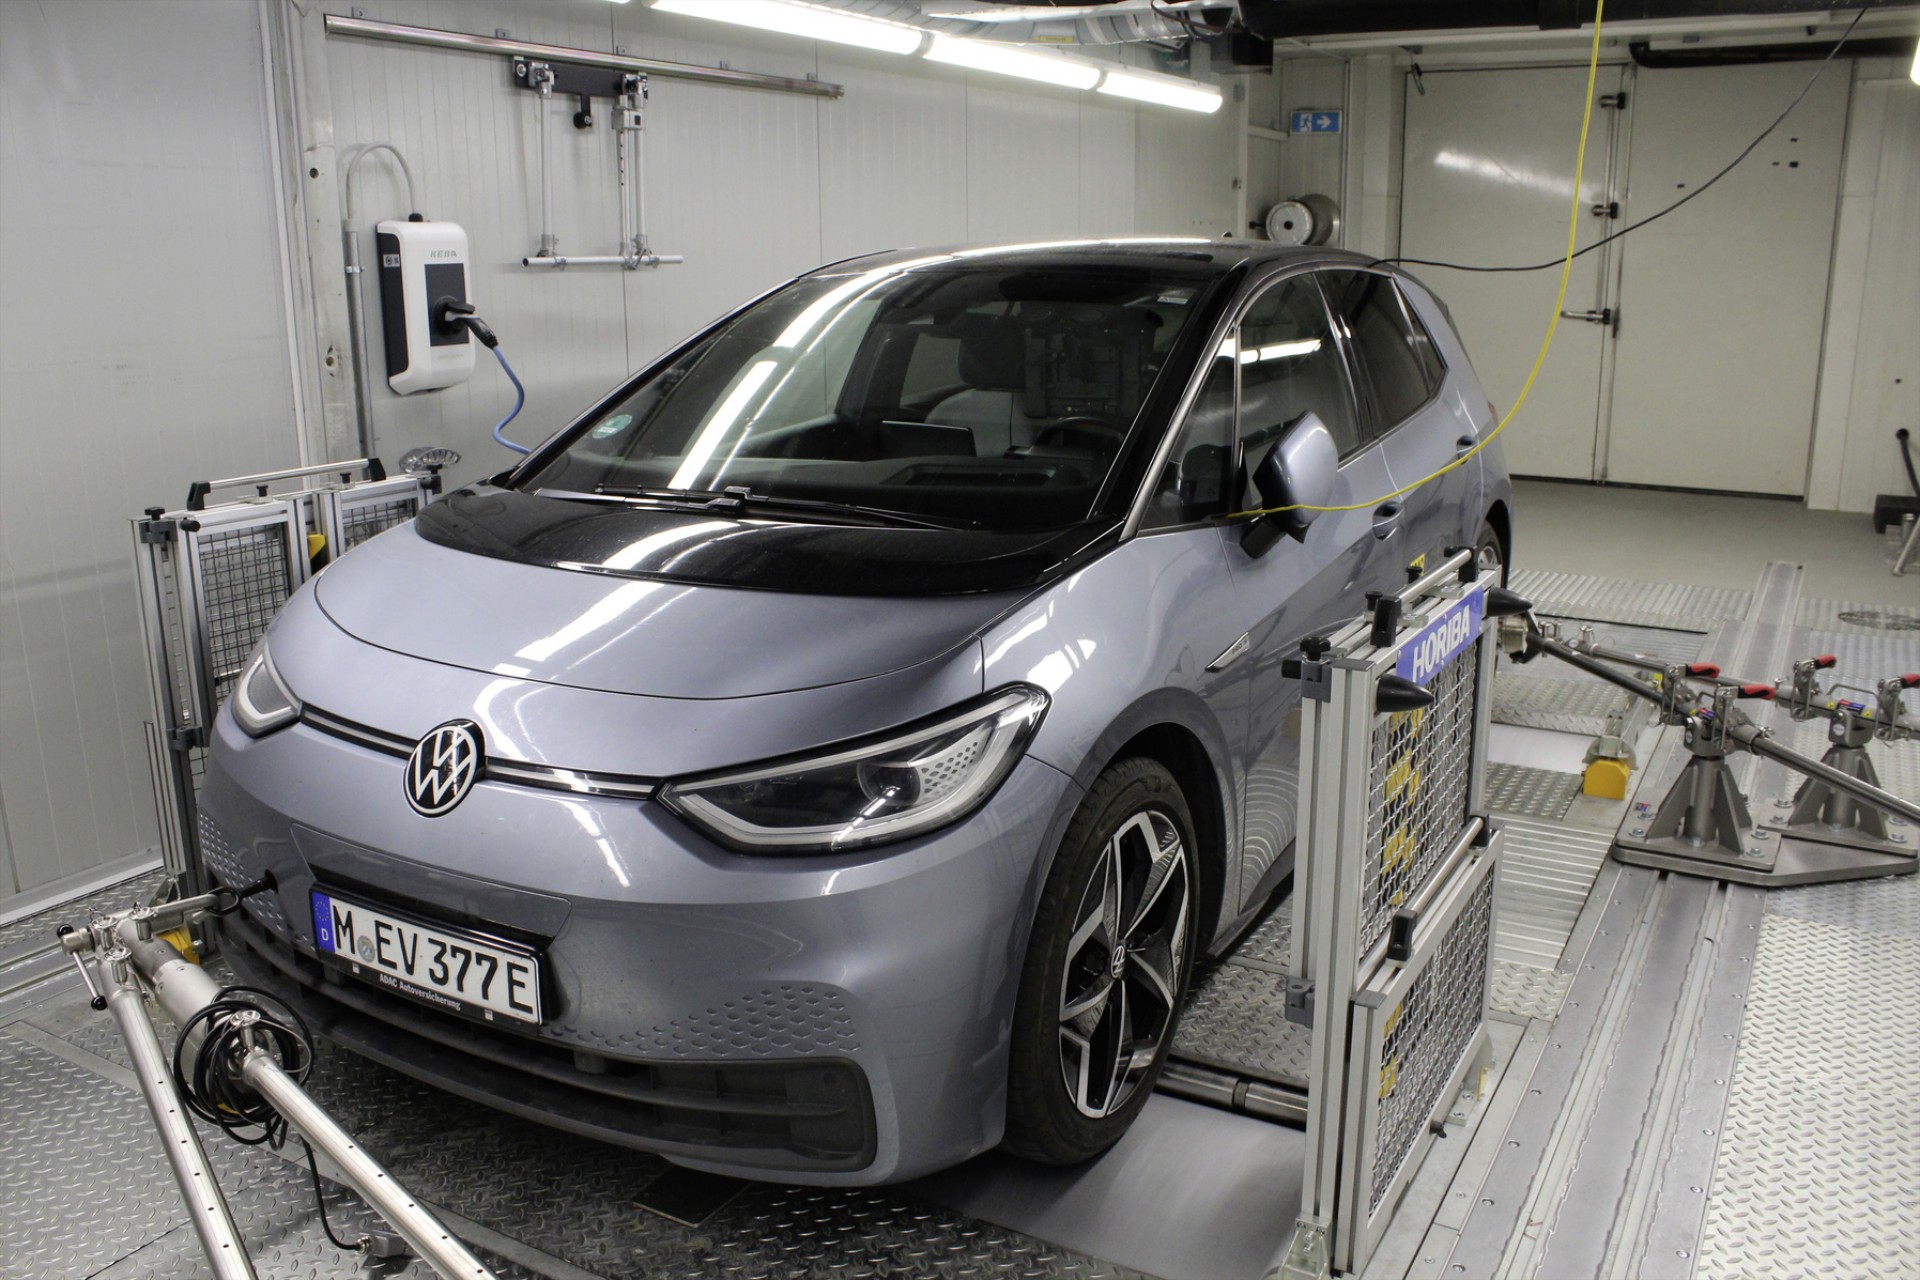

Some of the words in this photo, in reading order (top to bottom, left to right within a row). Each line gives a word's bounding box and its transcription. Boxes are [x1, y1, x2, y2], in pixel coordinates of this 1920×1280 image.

[430, 250, 457, 258] KEBA
[1412, 604, 1470, 683] HORIBA
[321, 928, 329, 941] D
[333, 905, 355, 954] M
[379, 973, 398, 987] ADAC
[399, 981, 461, 1012] Autoversicherung
